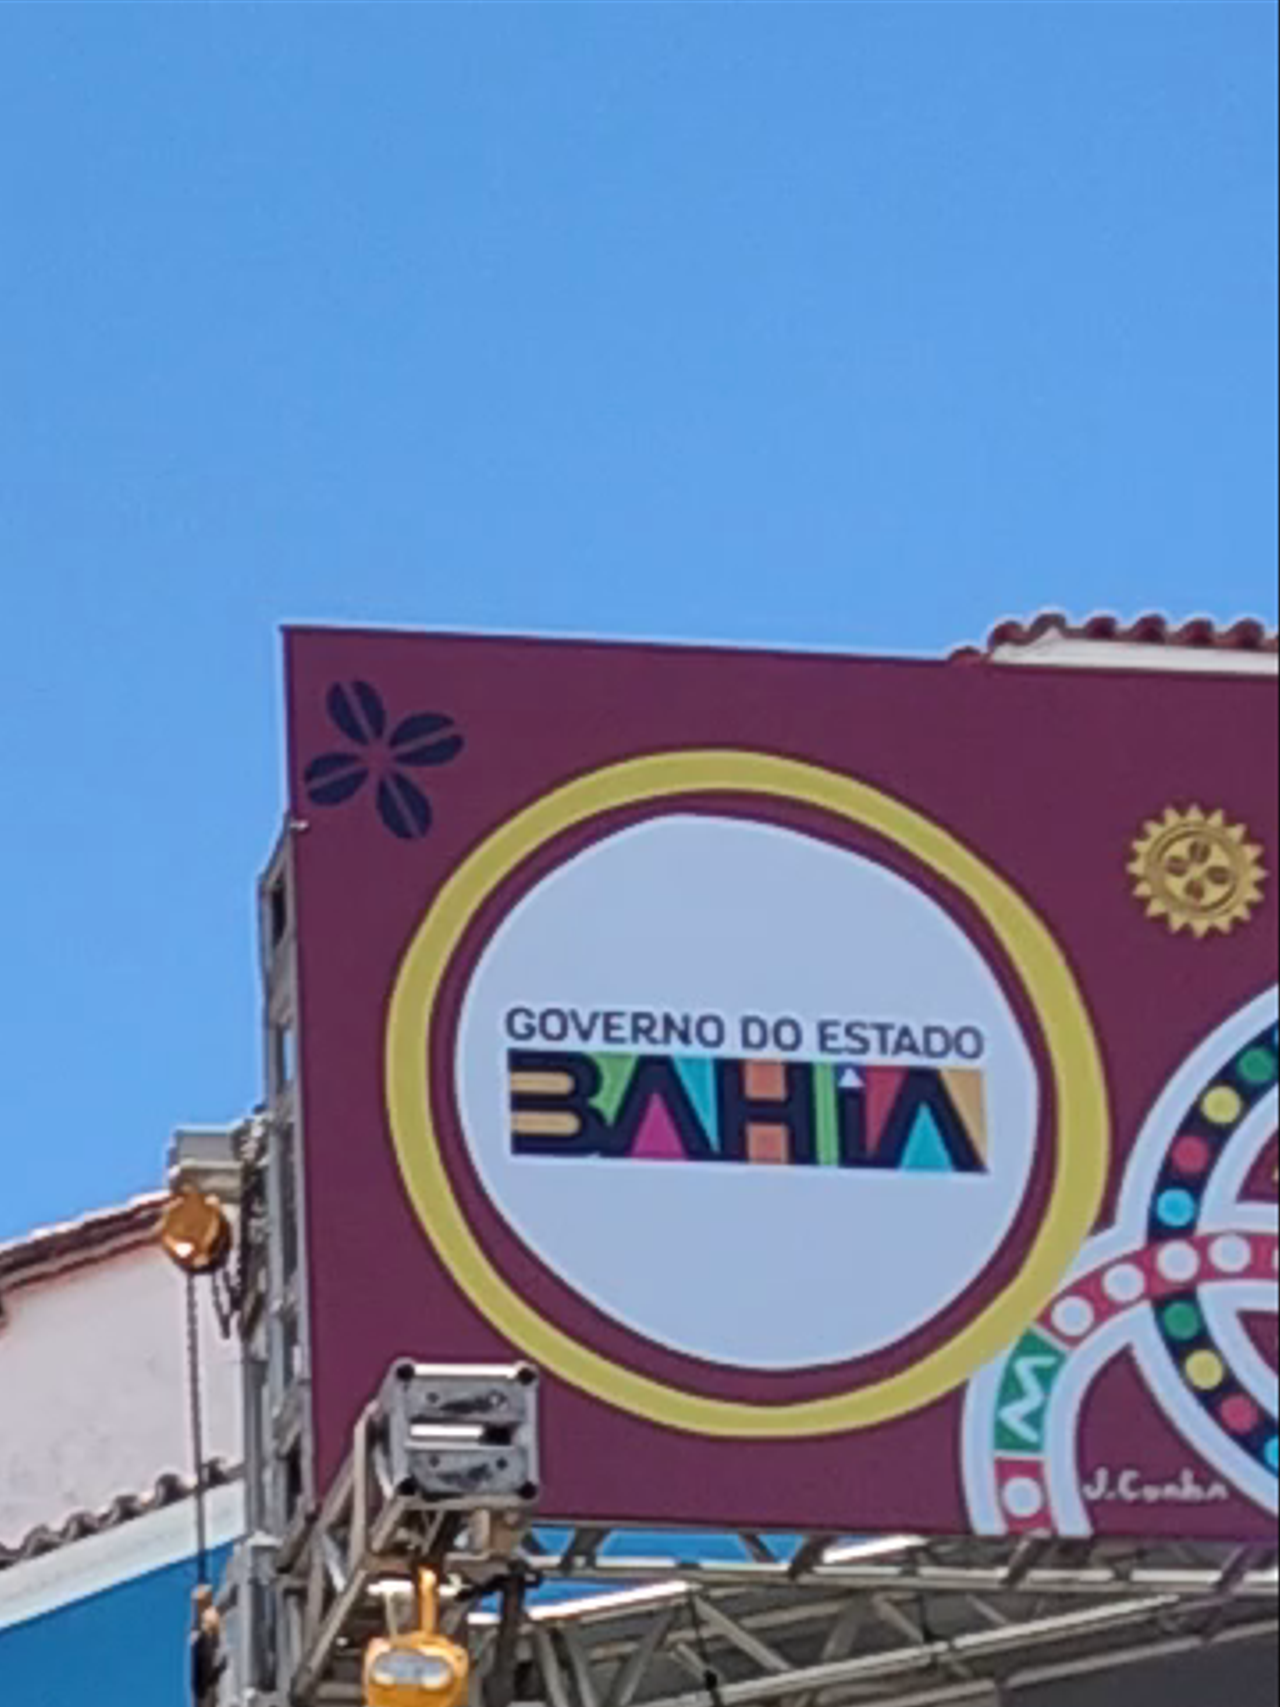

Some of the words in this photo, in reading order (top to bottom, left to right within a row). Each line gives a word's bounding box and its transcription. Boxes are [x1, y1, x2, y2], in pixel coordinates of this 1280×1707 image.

[505, 1007, 726, 1049] GOVERNO
[740, 1016, 803, 1053] DO
[818, 1020, 985, 1060] ESTADO
[507, 1048, 988, 1174] BAHIA
